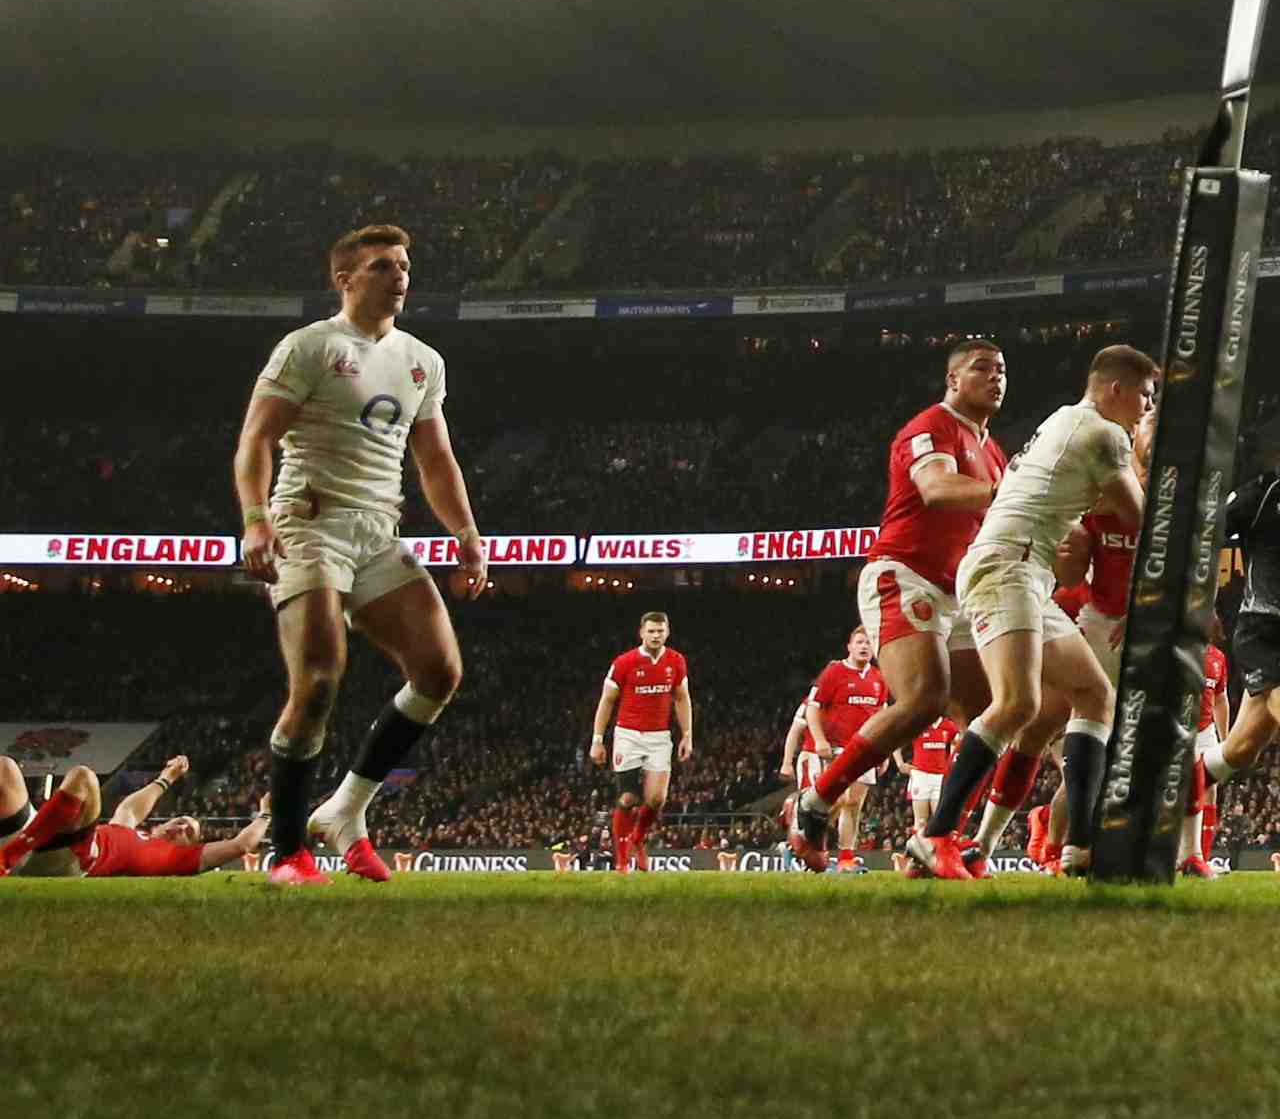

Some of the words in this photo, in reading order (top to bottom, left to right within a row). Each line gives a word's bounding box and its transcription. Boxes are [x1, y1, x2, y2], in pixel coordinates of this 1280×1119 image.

[1176, 243, 1209, 358] GUINNESS
[1225, 250, 1251, 362] GUINNESS
[66, 537, 225, 562] ENGLAND
[429, 538, 568, 563] ENLAND
[596, 539, 682, 559] WALES
[752, 529, 878, 560] ENGLAND
[1144, 465, 1179, 579] GUINNESS
[1194, 470, 1223, 583] GUINNESS
[1111, 689, 1146, 803] GUINNESS
[414, 852, 528, 872] GUINNESS
